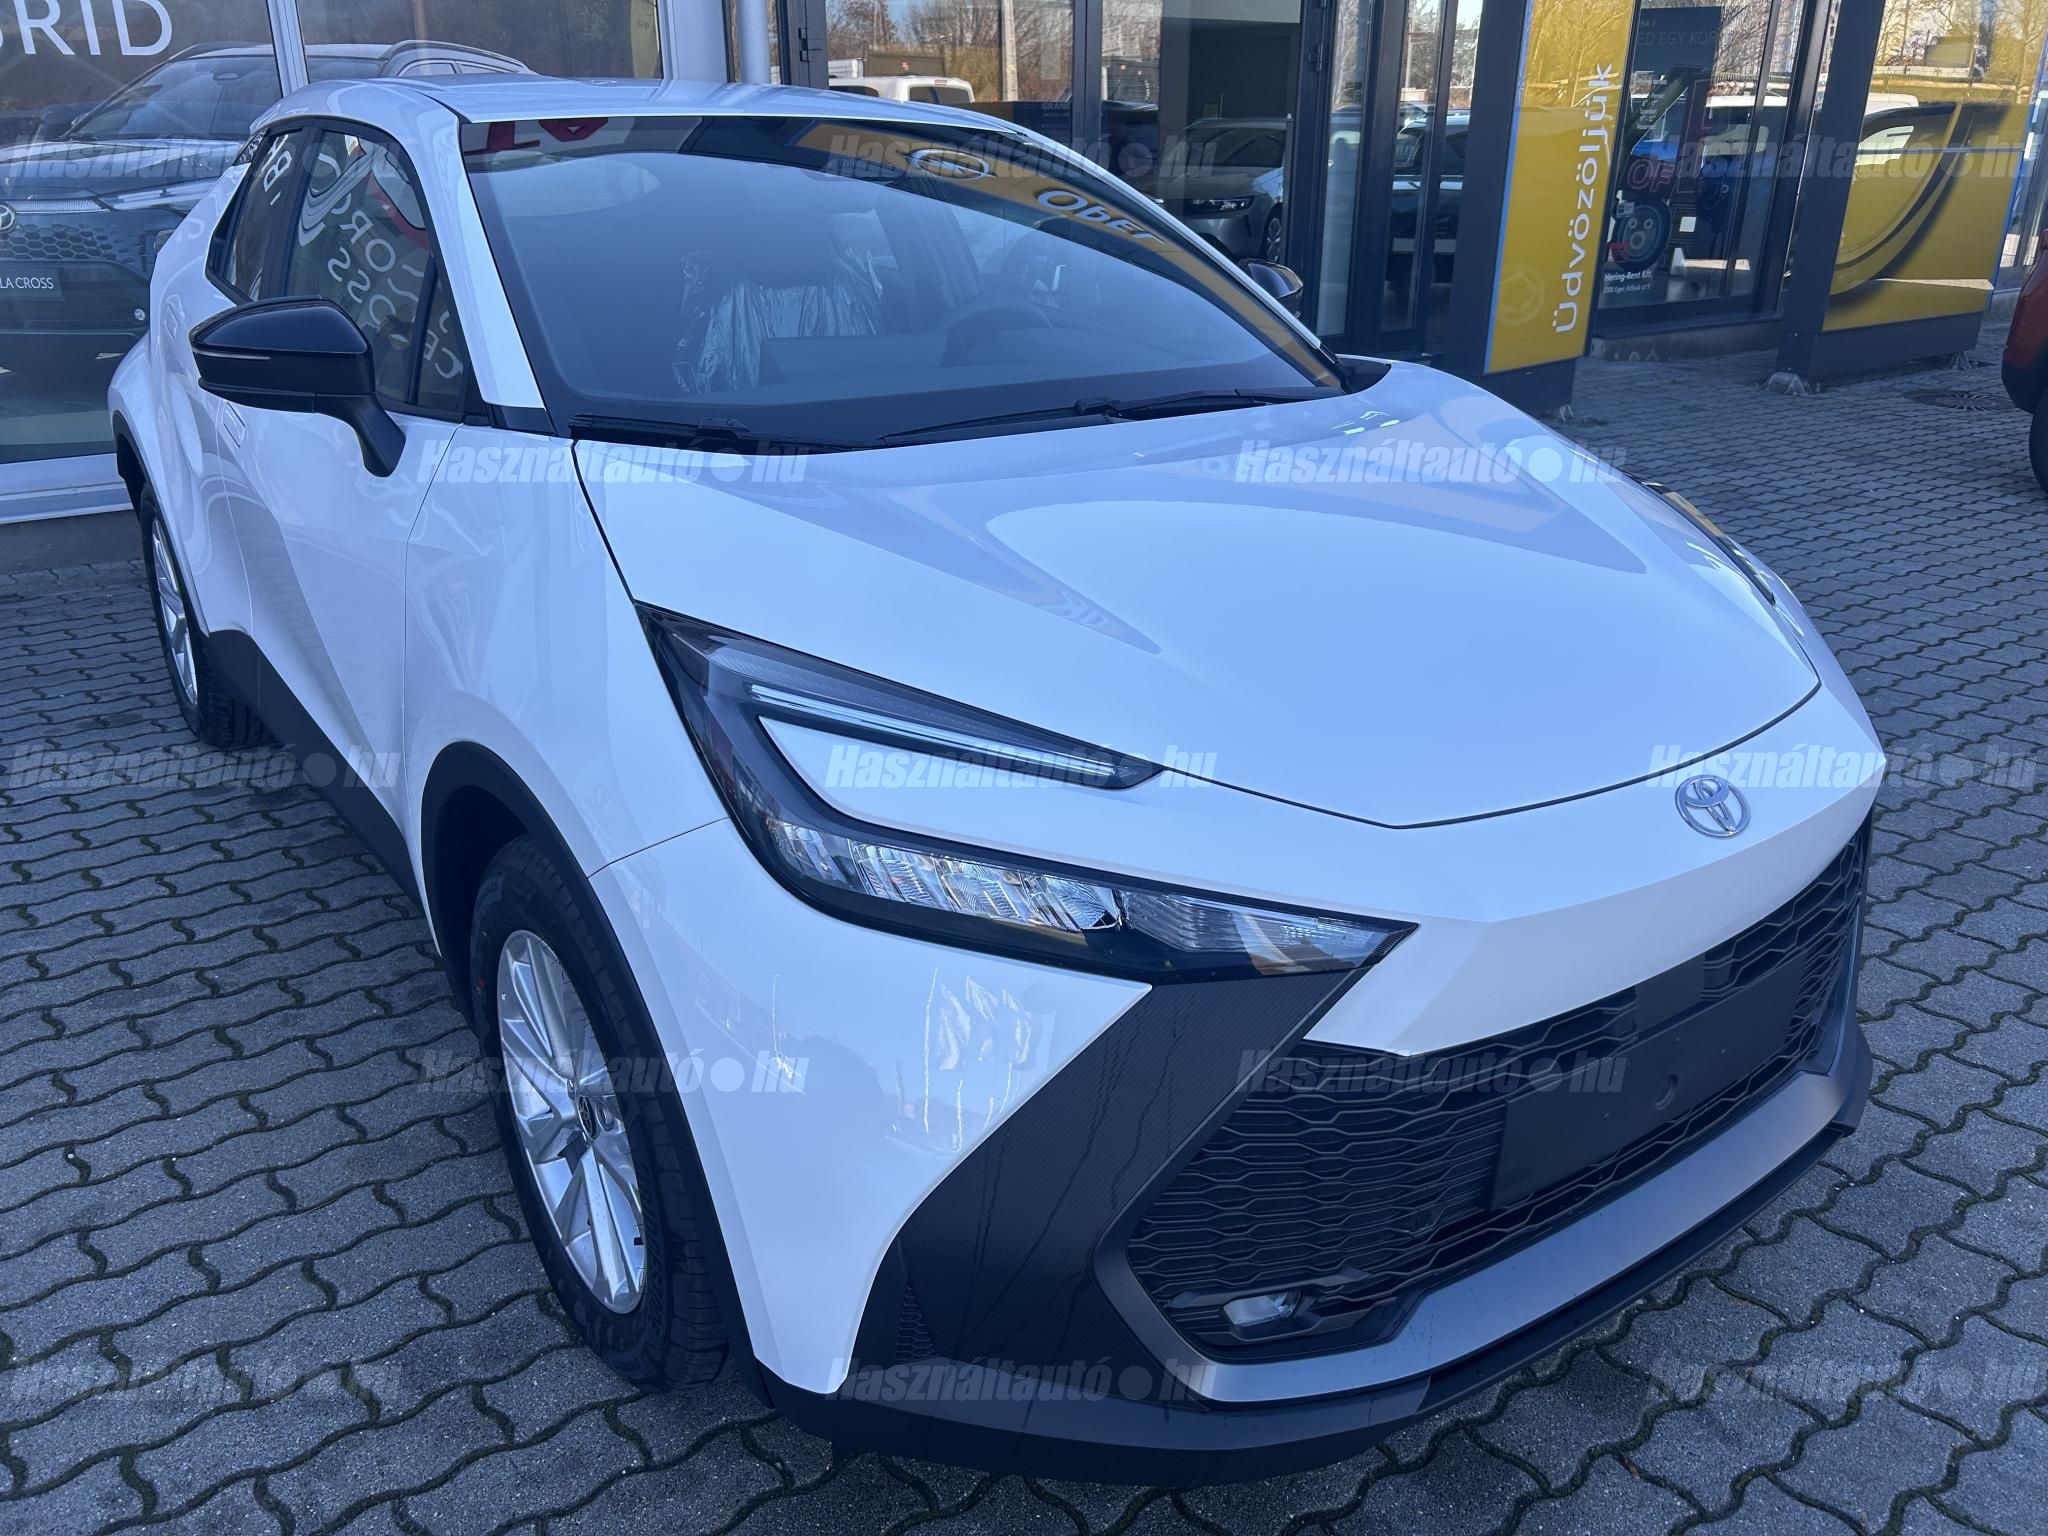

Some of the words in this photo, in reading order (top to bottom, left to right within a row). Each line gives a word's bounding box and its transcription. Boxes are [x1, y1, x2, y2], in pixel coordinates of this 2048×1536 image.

[0, 0, 173, 56] RID
[1552, 63, 1612, 333] Üdvözöljük
[15, 277, 54, 290] CROSS
